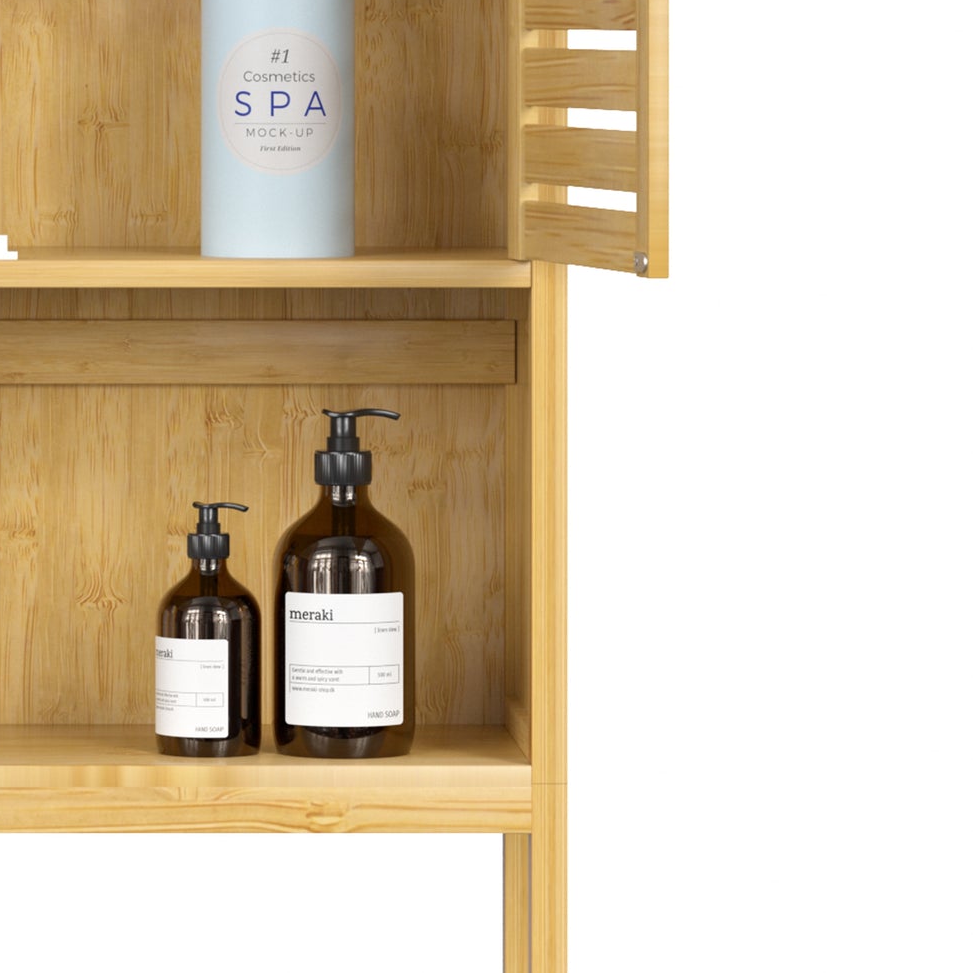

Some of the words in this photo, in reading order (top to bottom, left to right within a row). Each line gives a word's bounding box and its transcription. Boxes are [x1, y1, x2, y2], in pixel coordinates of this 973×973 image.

[270, 48, 290, 64] #1
[243, 70, 316, 83] Cosmetics
[234, 90, 327, 117] SPA
[245, 127, 314, 138] MOCK-UP
[289, 609, 334, 621] meraki
[367, 711, 384, 719] HAND
[384, 710, 400, 718] SOAP
